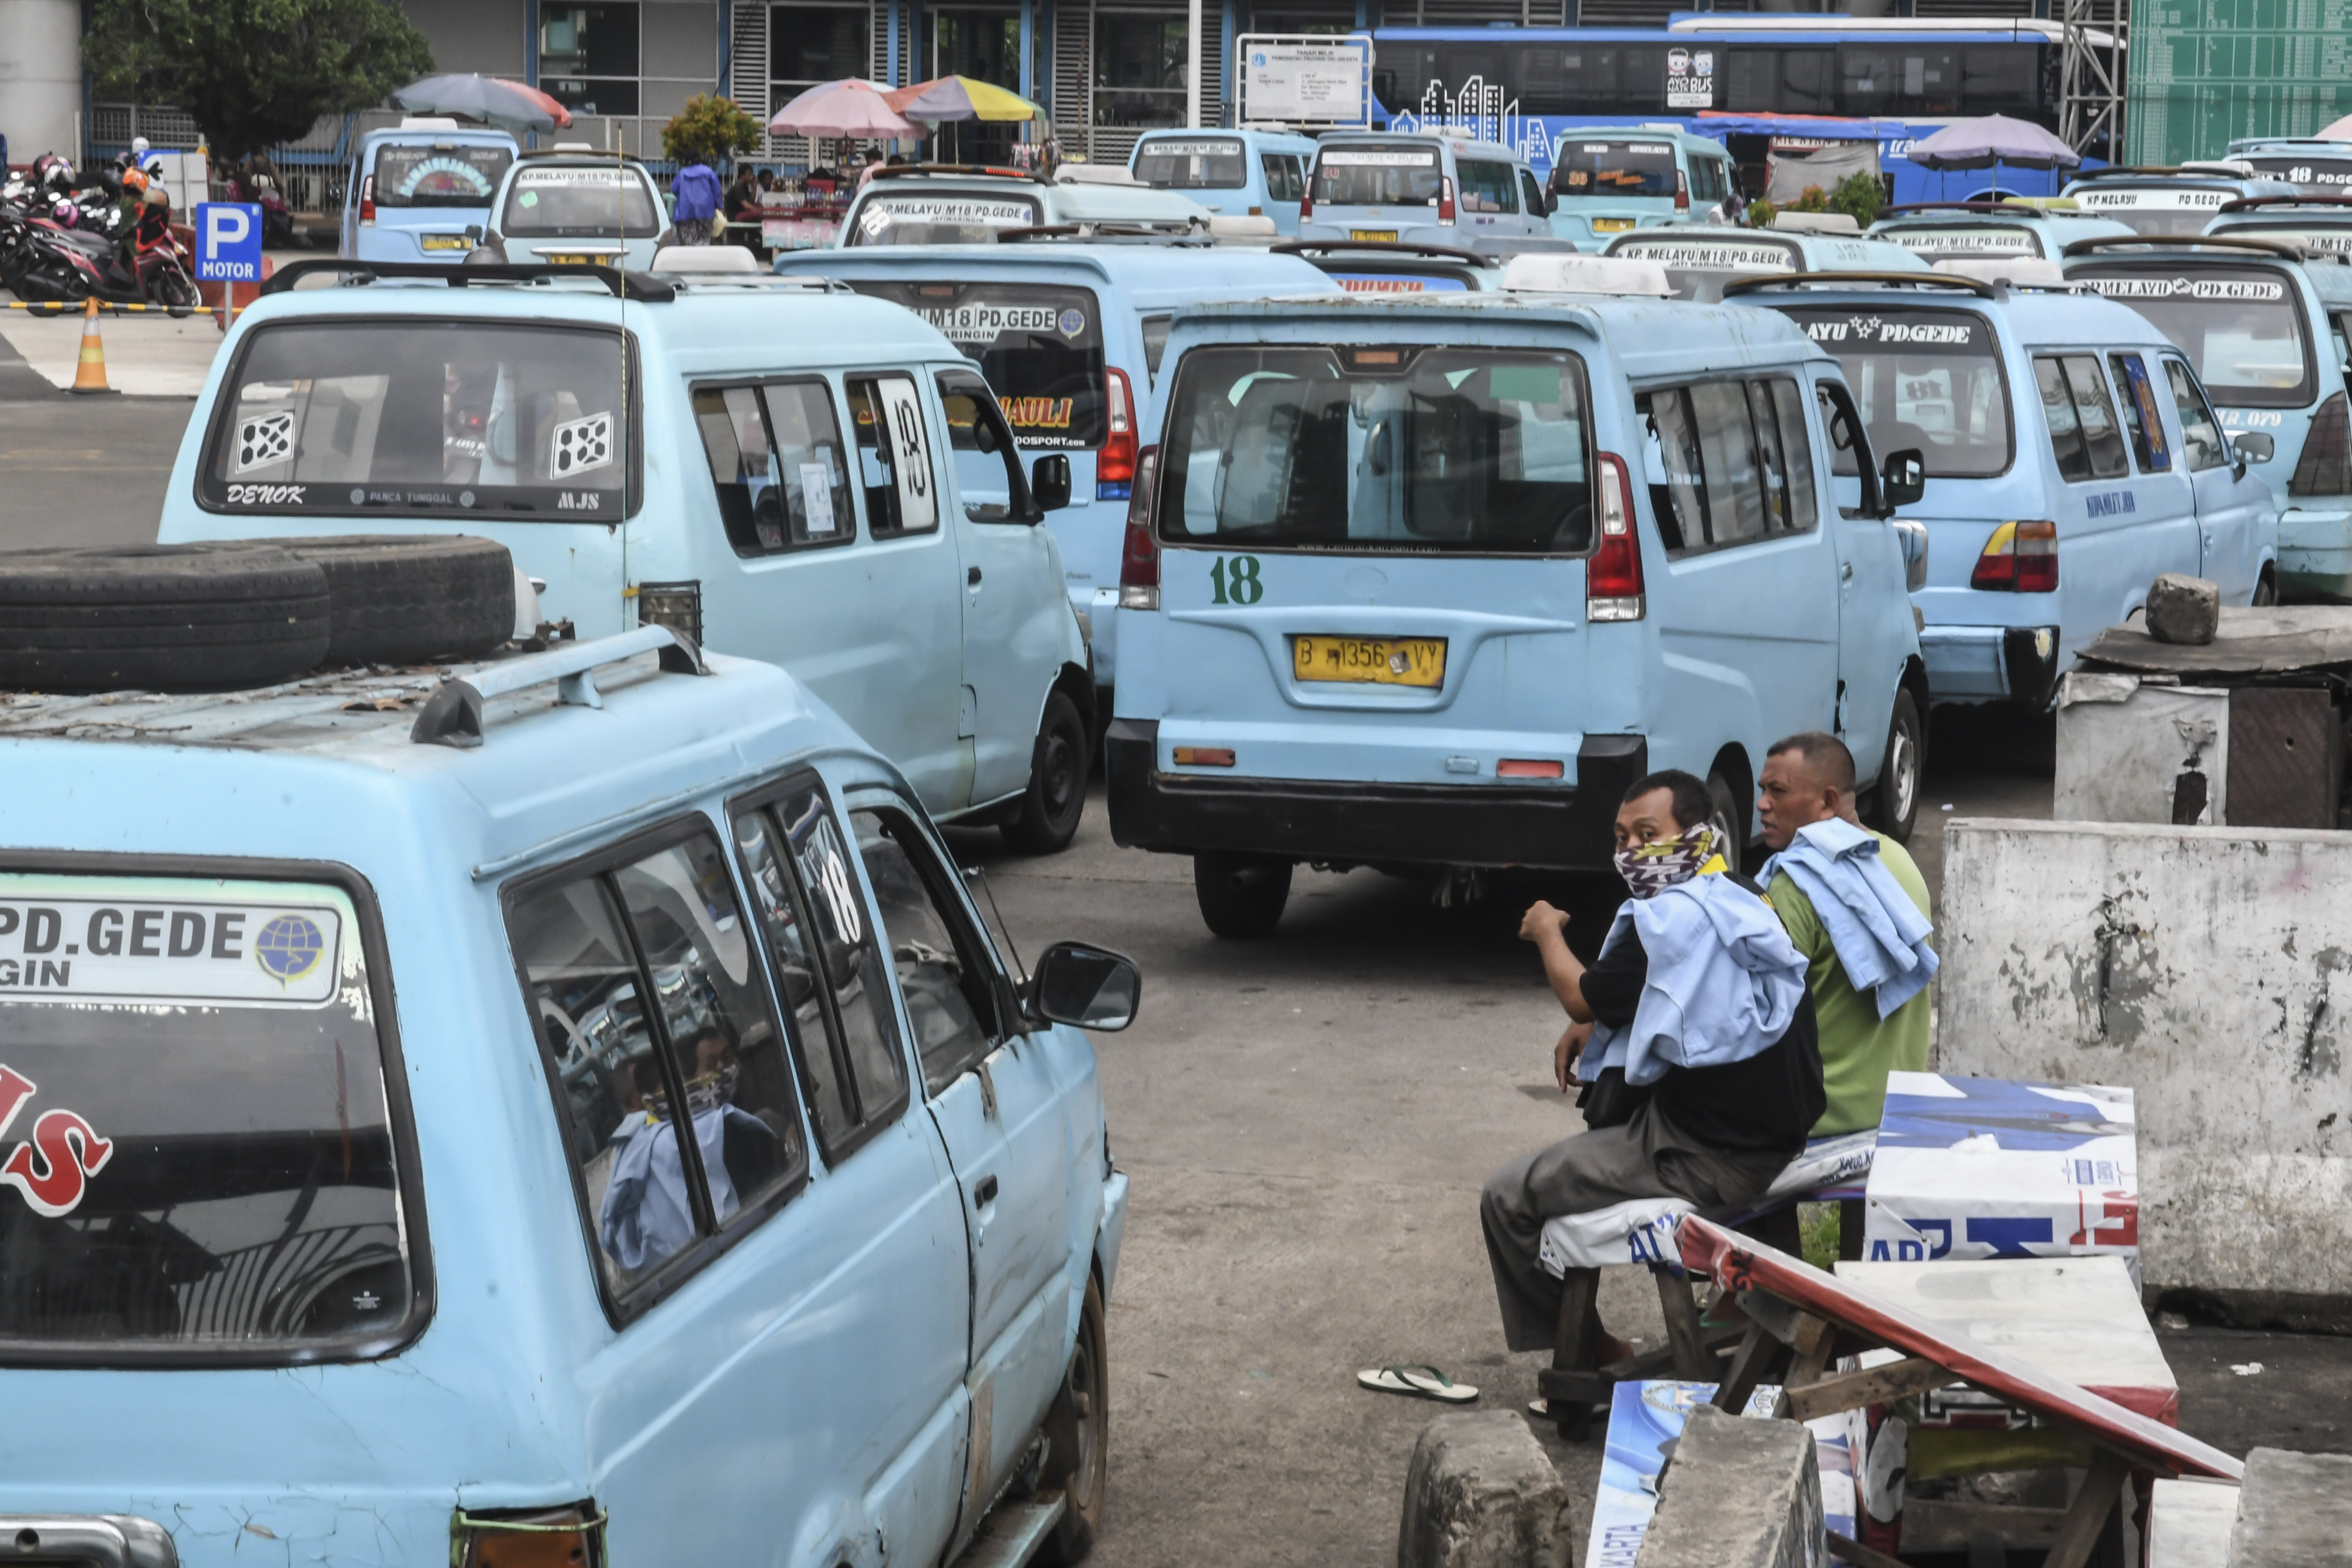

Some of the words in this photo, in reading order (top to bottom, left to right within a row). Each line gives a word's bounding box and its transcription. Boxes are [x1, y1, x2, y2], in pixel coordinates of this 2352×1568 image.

[1690, 76, 1712, 92] BUS
[2288, 166, 2311, 183] 18
[860, 204, 890, 236] 18
[945, 205, 971, 215] M18
[975, 206, 1021, 218] PD.GEDE
[206, 207, 249, 259] P
[1902, 238, 1943, 246] MELAYU
[1949, 238, 1970, 247] M18
[1977, 238, 2022, 247] PD.GEDE
[1647, 249, 1696, 260] MELAYU
[1699, 250, 1726, 262] M18
[1731, 252, 1783, 265] PD.GEDE
[202, 262, 254, 278] MOTOR
[978, 309, 1055, 328] PD.GEDE
[1879, 323, 1970, 344] PD.GEDE
[228, 484, 306, 505] DENOK
[557, 492, 599, 510] MJS
[1211, 556, 1264, 605] 18
[1301, 640, 1312, 664] B
[1341, 641, 1385, 667] 1356
[1414, 644, 1436, 670] VY
[821, 849, 861, 945] 18
